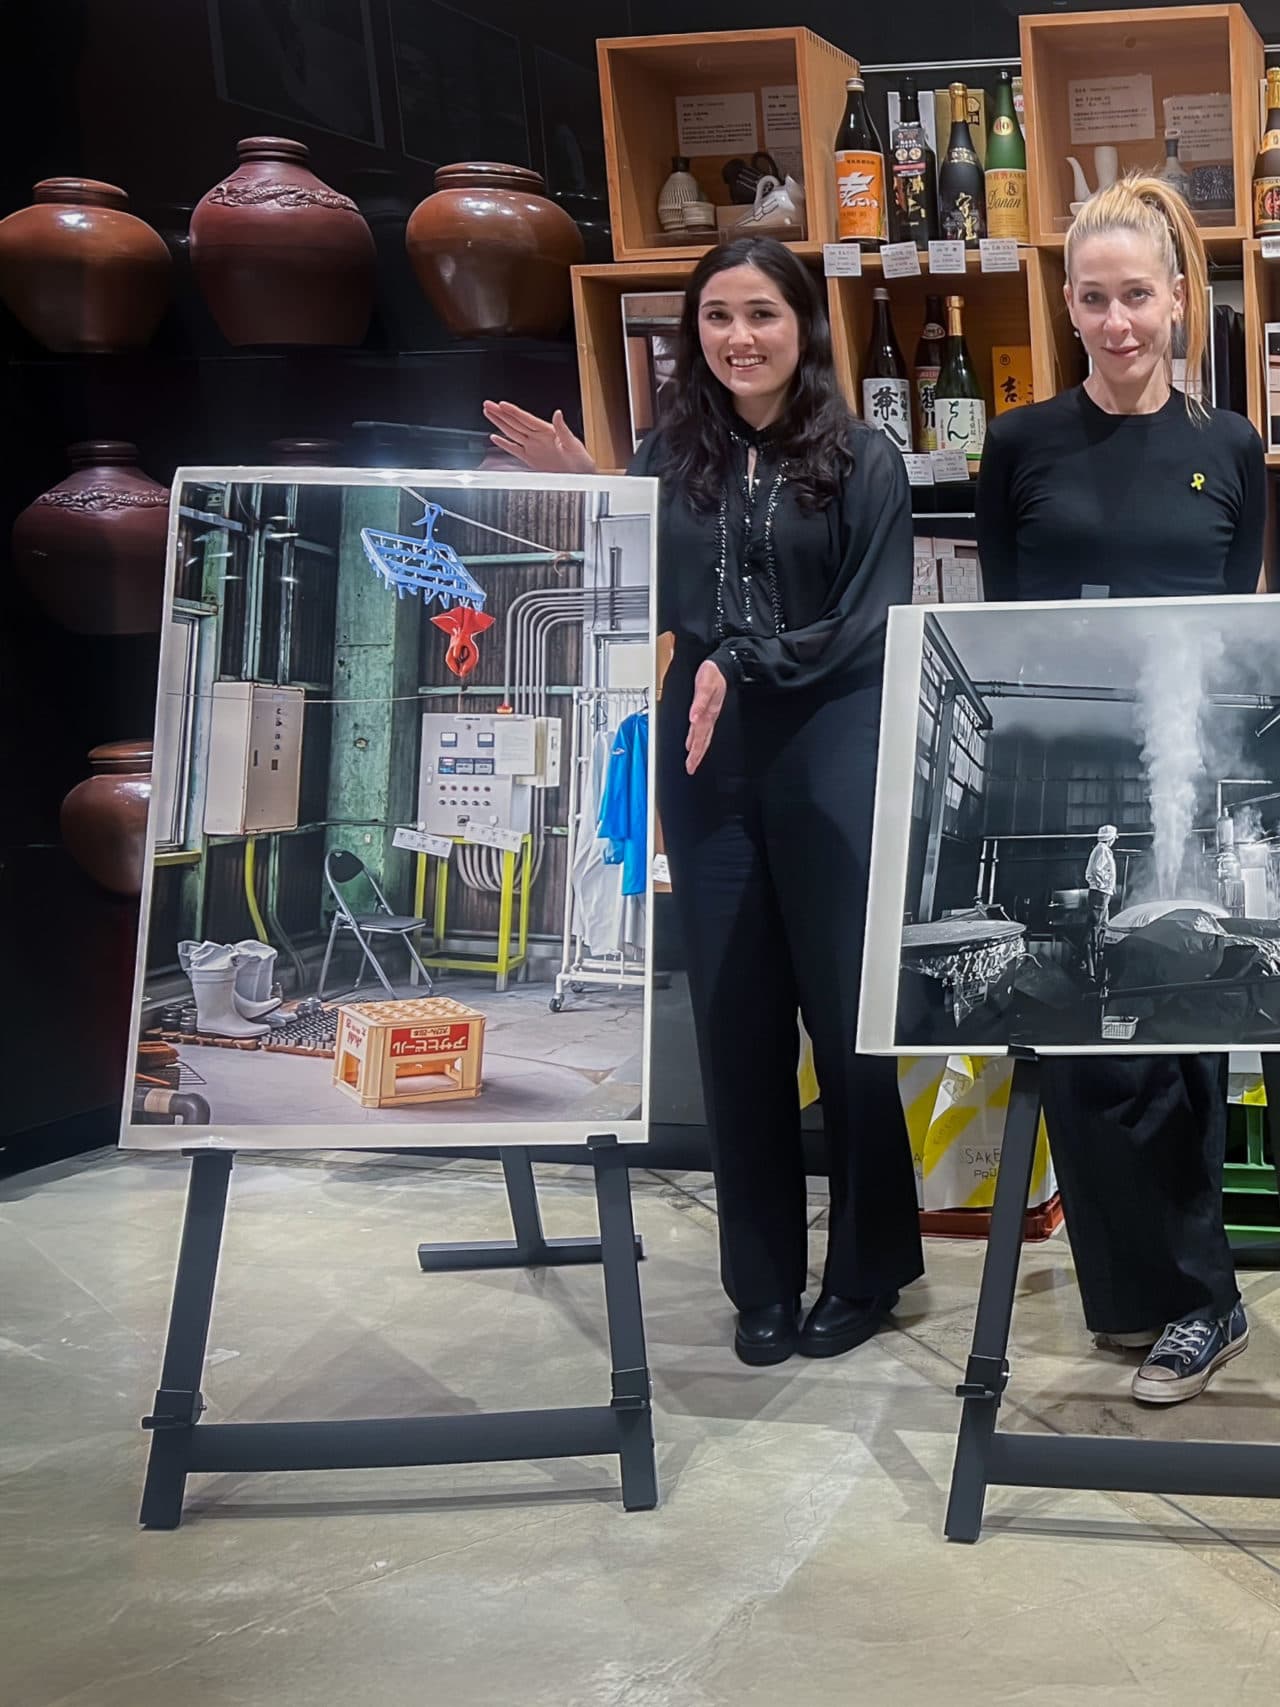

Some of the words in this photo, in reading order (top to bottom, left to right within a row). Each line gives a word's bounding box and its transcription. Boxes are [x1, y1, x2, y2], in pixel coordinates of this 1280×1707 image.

[872, 386, 907, 446] 兼八
[392, 1036, 467, 1055] アサヒビール
